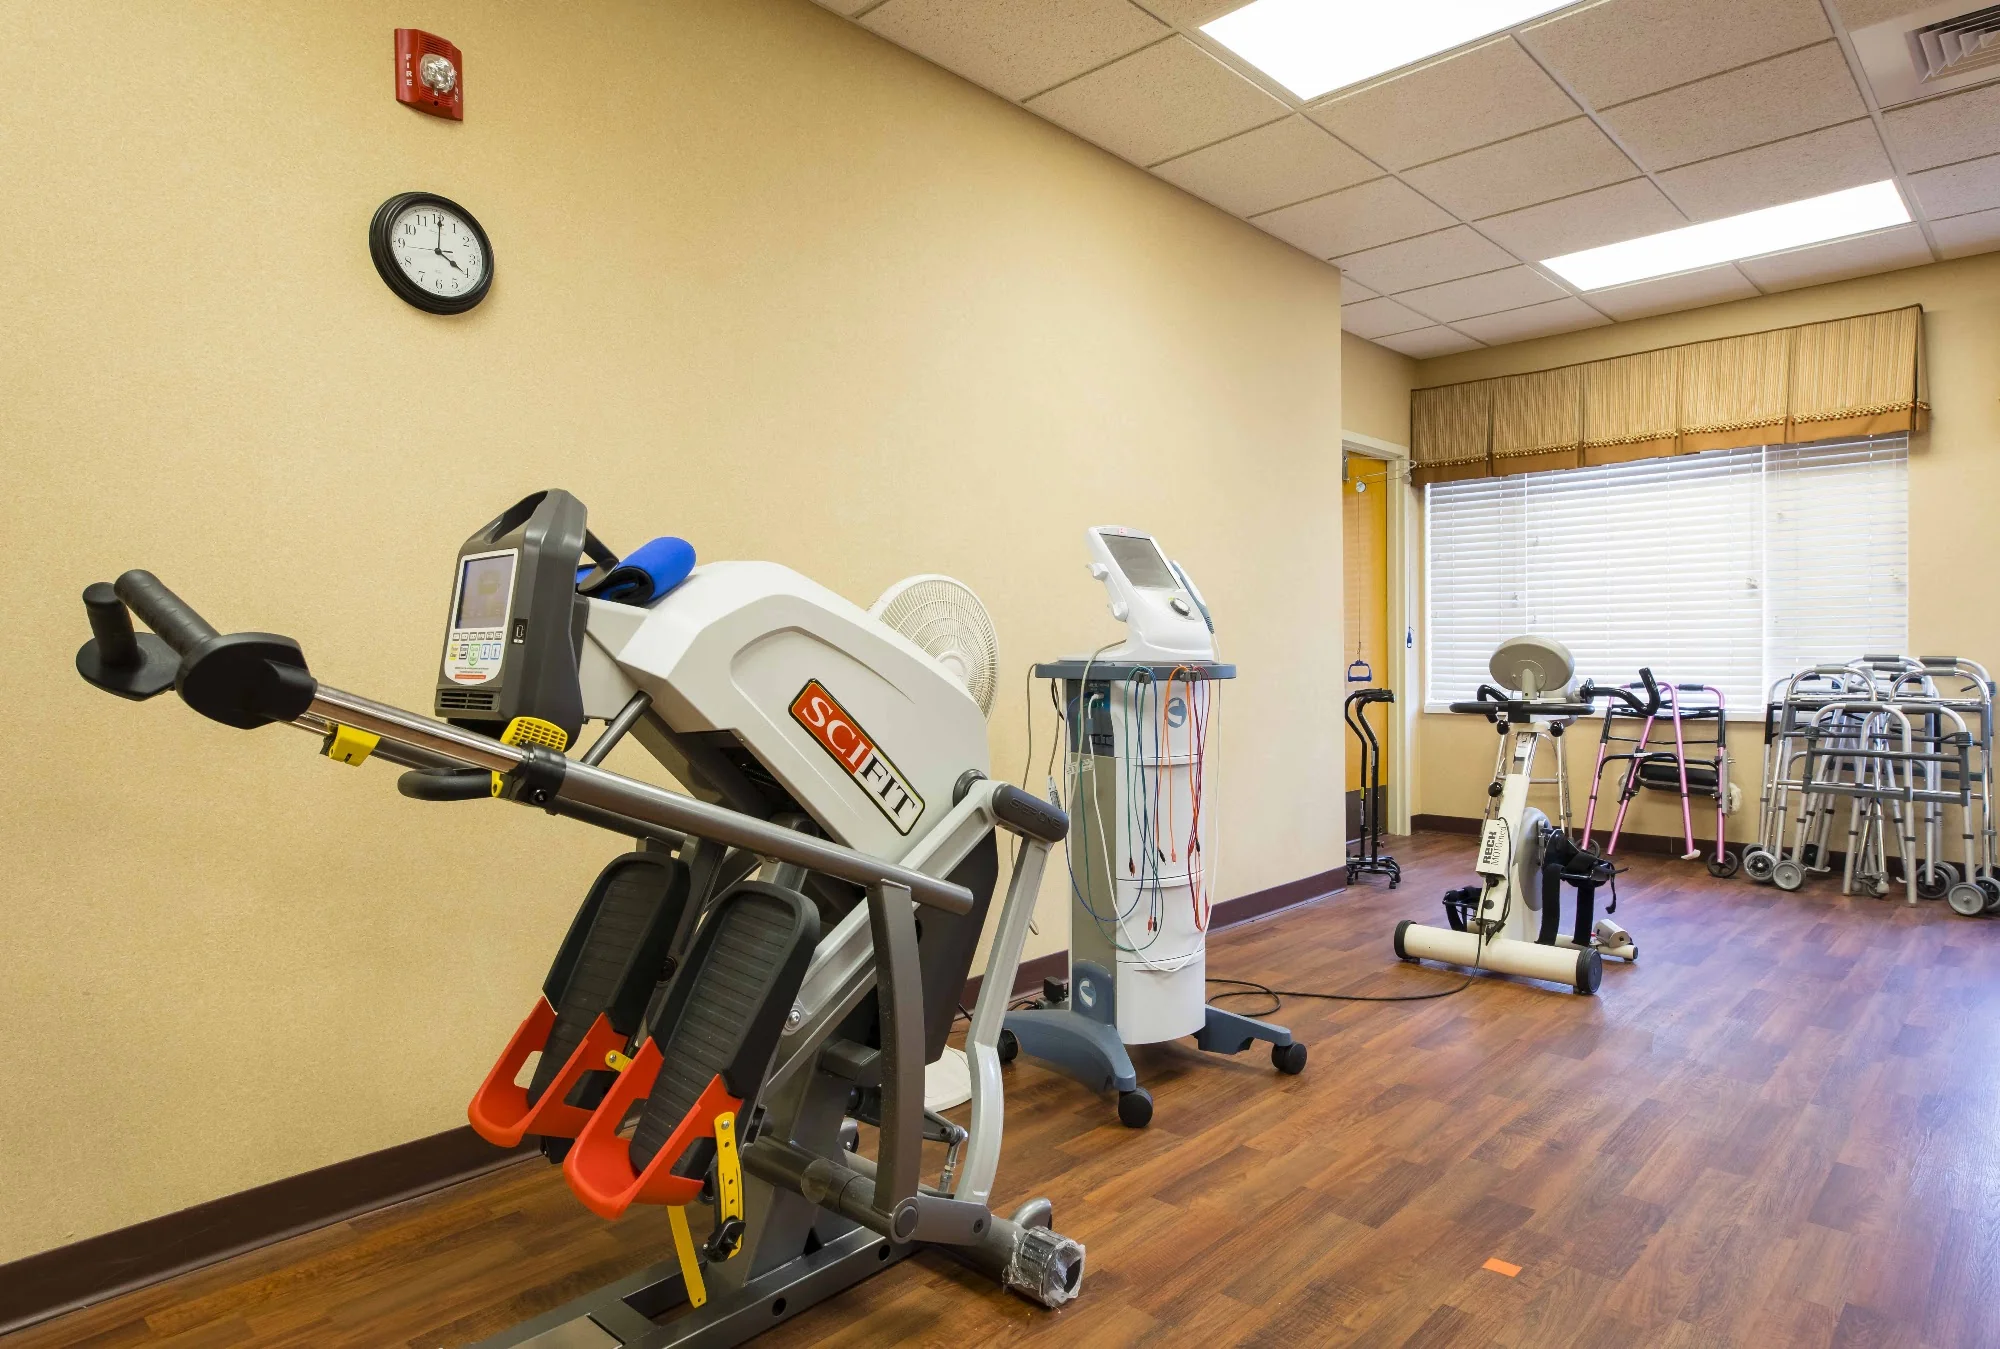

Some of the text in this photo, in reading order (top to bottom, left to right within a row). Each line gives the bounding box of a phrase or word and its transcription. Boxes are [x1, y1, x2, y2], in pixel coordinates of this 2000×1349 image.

[405, 53, 413, 86] FIRE
[416, 214, 428, 227] 11
[432, 213, 445, 227] 12
[404, 223, 417, 235] 10
[452, 223, 456, 234] 1
[398, 237, 406, 249] 9
[462, 235, 470, 248] 2
[404, 255, 412, 268] 8
[469, 253, 476, 266] 3
[418, 270, 426, 283] 7
[463, 267, 470, 279] 4
[435, 279, 443, 290] 6
[451, 277, 459, 290] 5
[801, 696, 916, 819] SCIFIT
